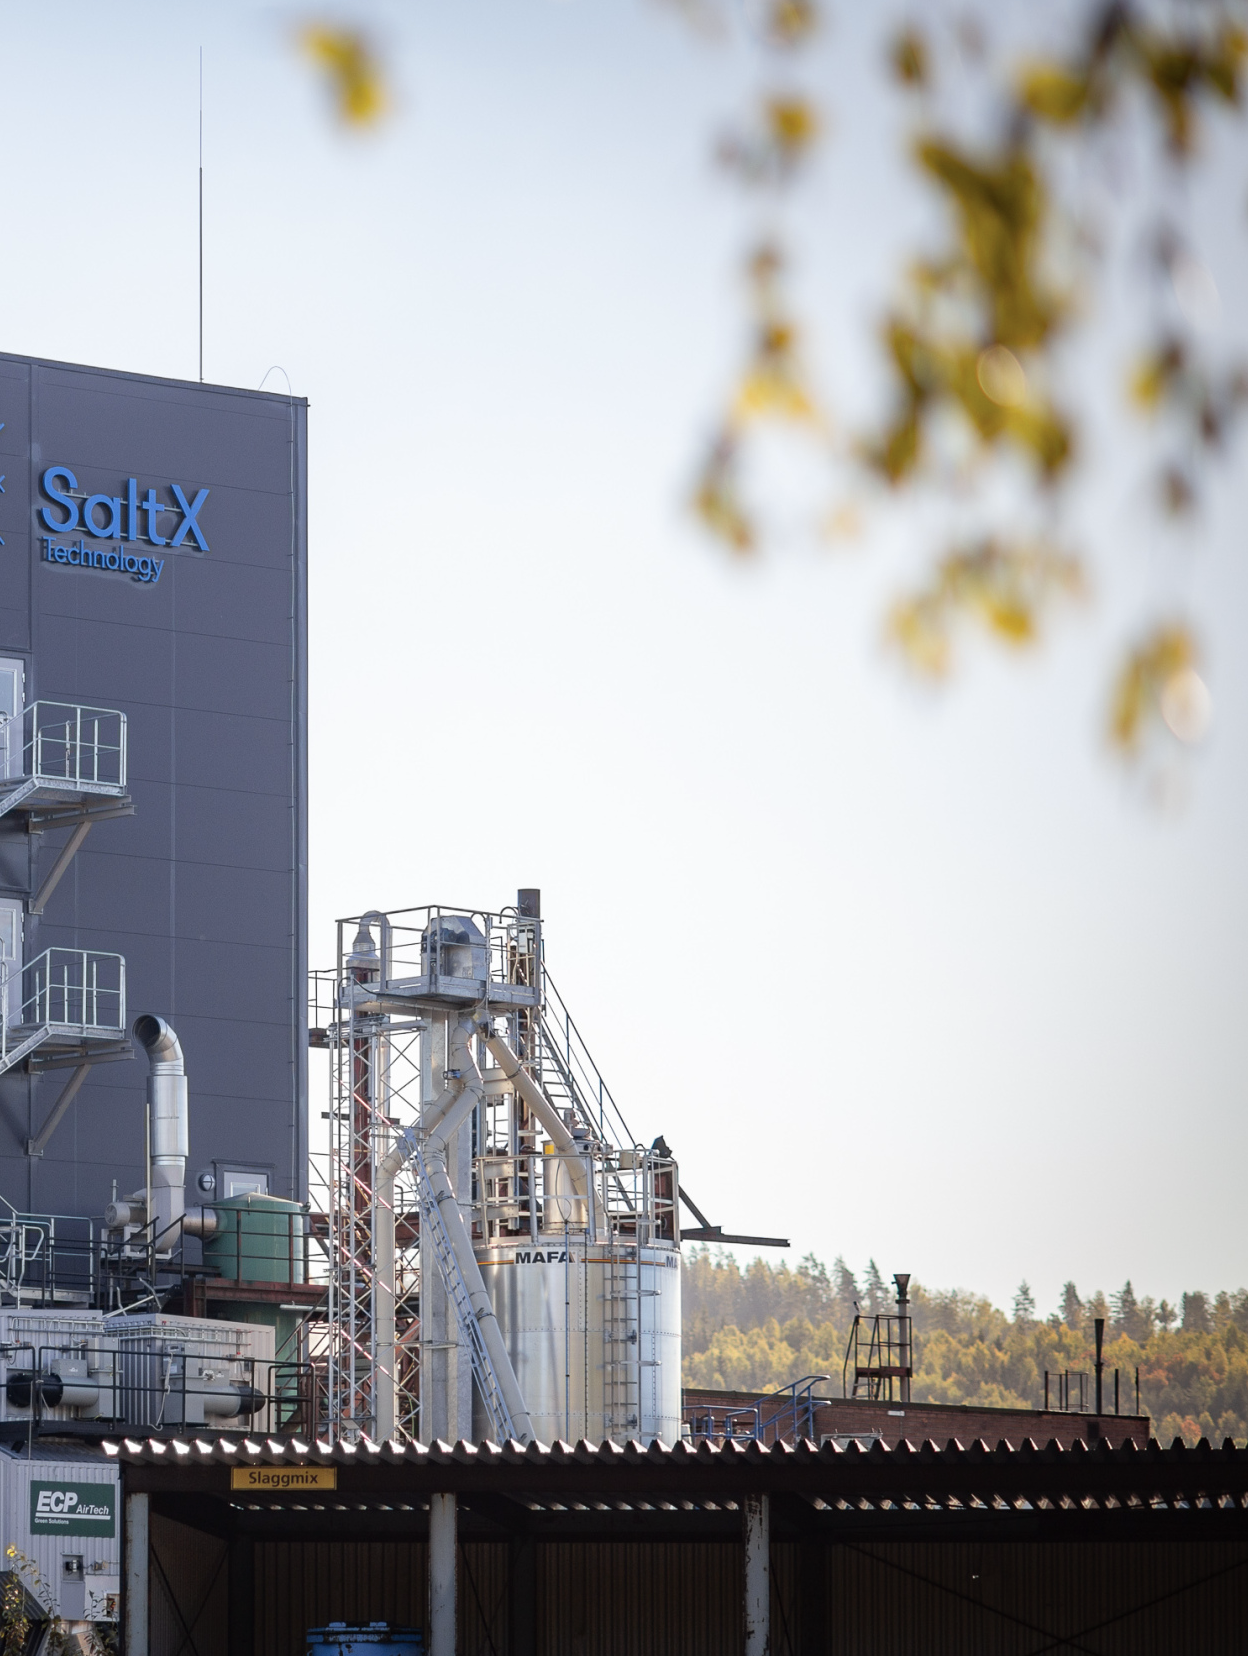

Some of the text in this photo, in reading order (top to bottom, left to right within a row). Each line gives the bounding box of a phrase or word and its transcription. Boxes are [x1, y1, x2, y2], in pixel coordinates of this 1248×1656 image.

[40, 466, 211, 551] SaltX
[42, 536, 165, 582] Technology
[515, 1251, 575, 1264] MAFA
[248, 1471, 319, 1487] Slaggmix
[36, 1490, 110, 1515] ECP AirTech
